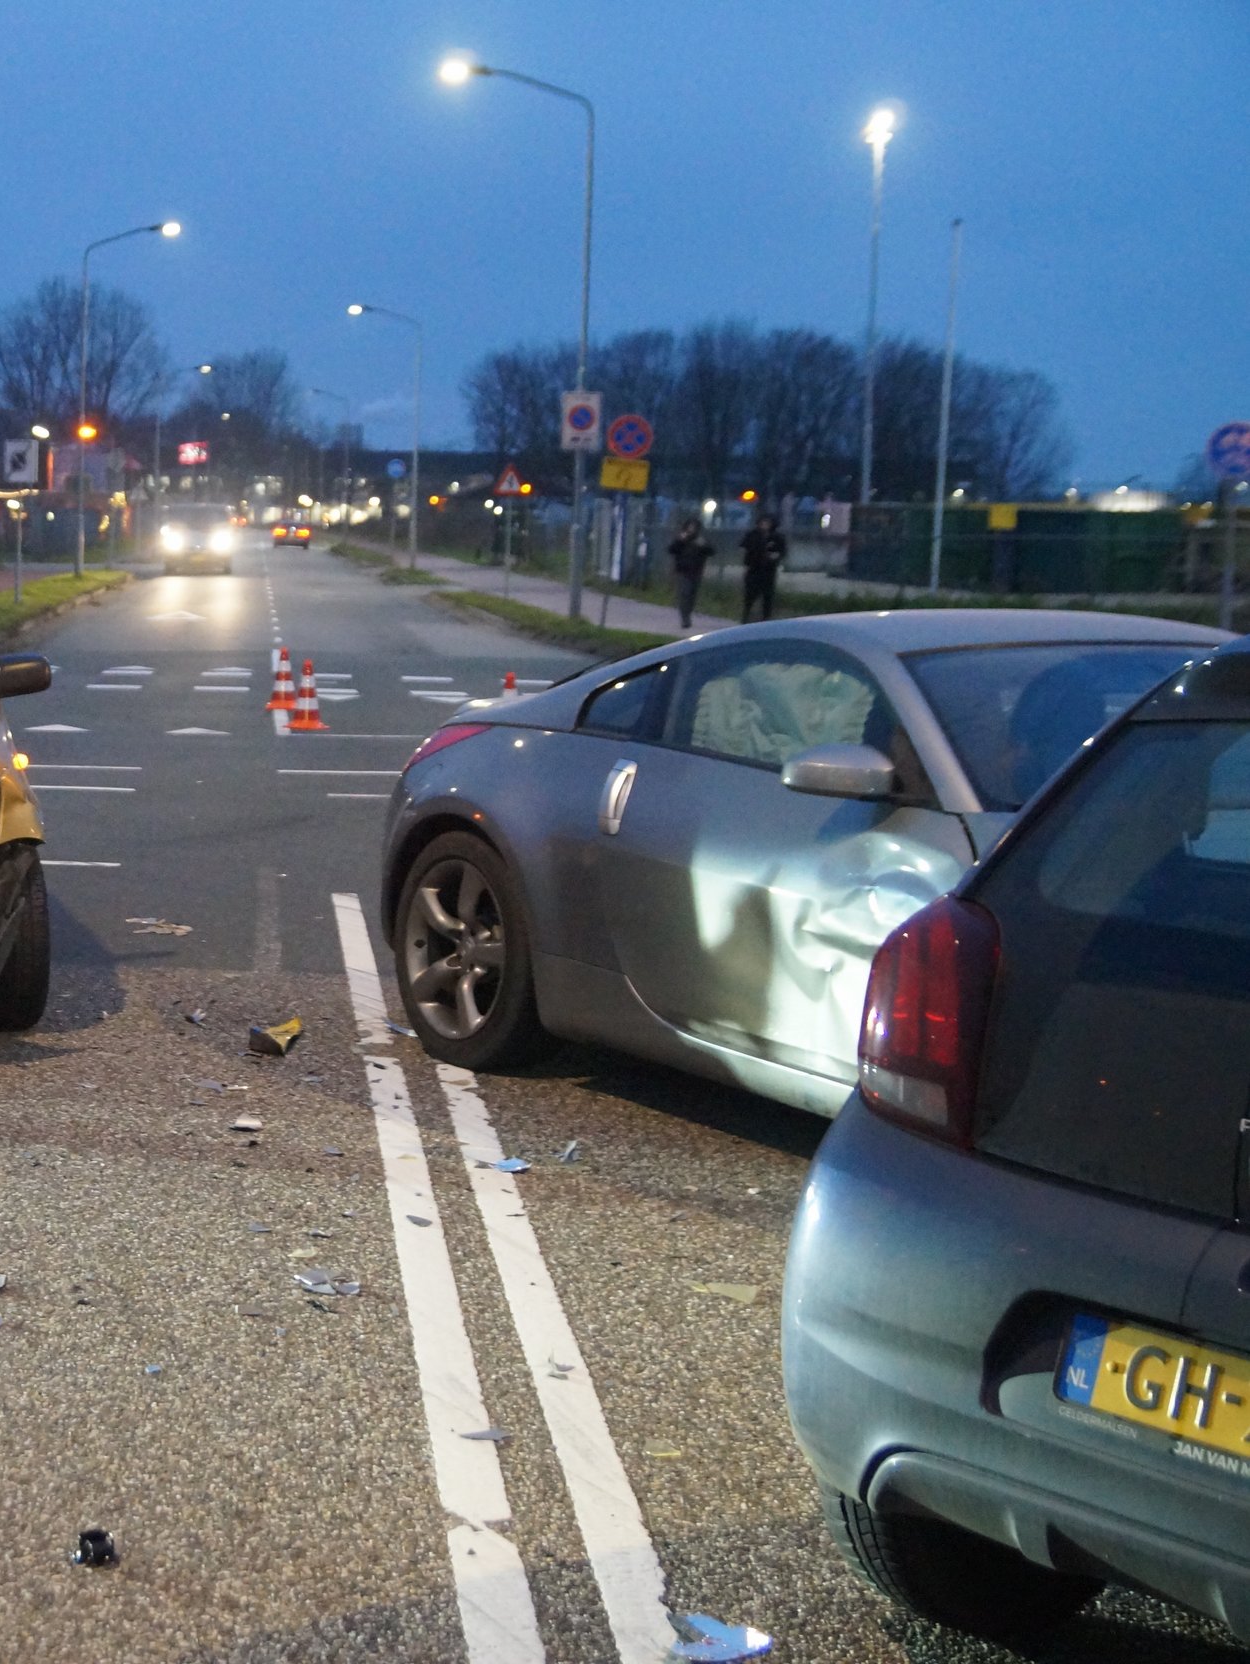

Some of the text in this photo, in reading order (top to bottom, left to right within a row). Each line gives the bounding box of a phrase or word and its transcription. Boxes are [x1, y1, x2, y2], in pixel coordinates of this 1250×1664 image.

[1065, 1365, 1089, 1390] NL
[1123, 1344, 1250, 1442] GH-
[1173, 1441, 1206, 1464] JAN
[1207, 1450, 1239, 1475] VAN
